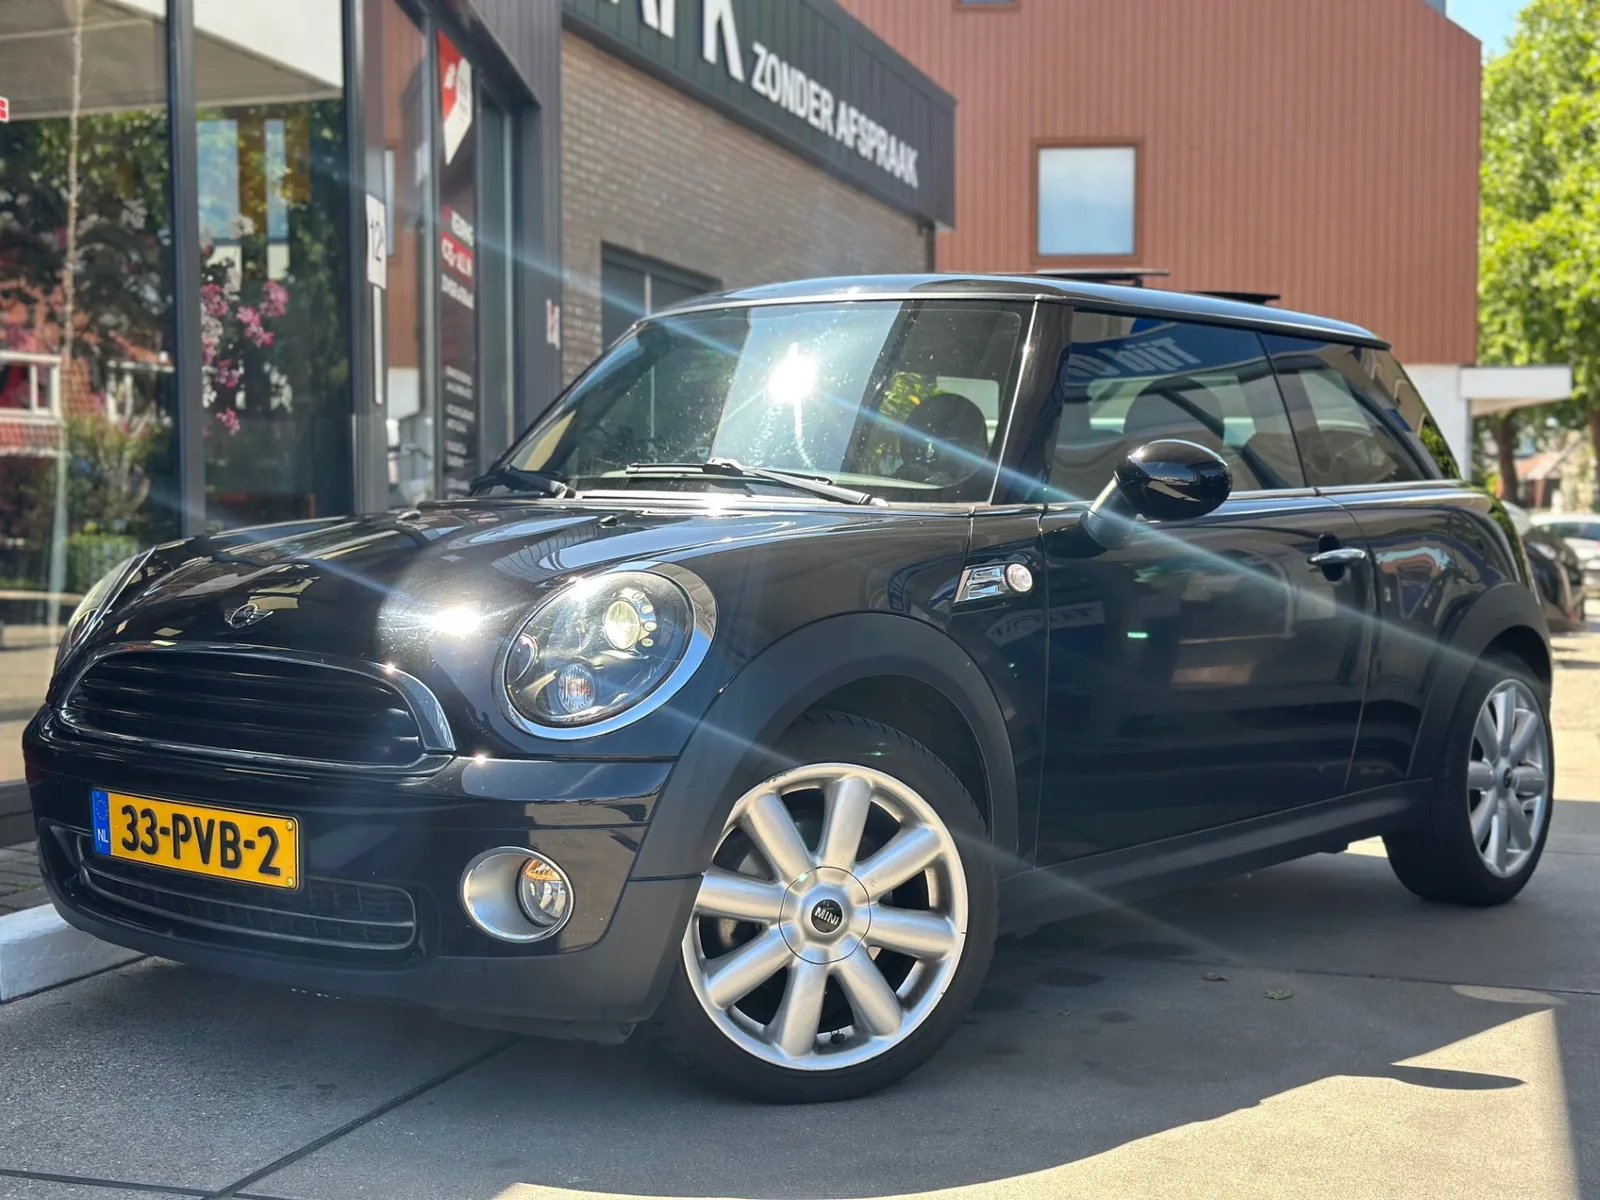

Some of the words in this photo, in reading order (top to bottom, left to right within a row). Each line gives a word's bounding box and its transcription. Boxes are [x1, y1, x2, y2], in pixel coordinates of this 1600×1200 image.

[751, 41, 836, 137] ZONDER
[835, 100, 919, 189] AFSPRAAK
[97, 827, 109, 843] NL
[121, 804, 281, 877] 33-PVB-2
[814, 906, 840, 926] MINI
